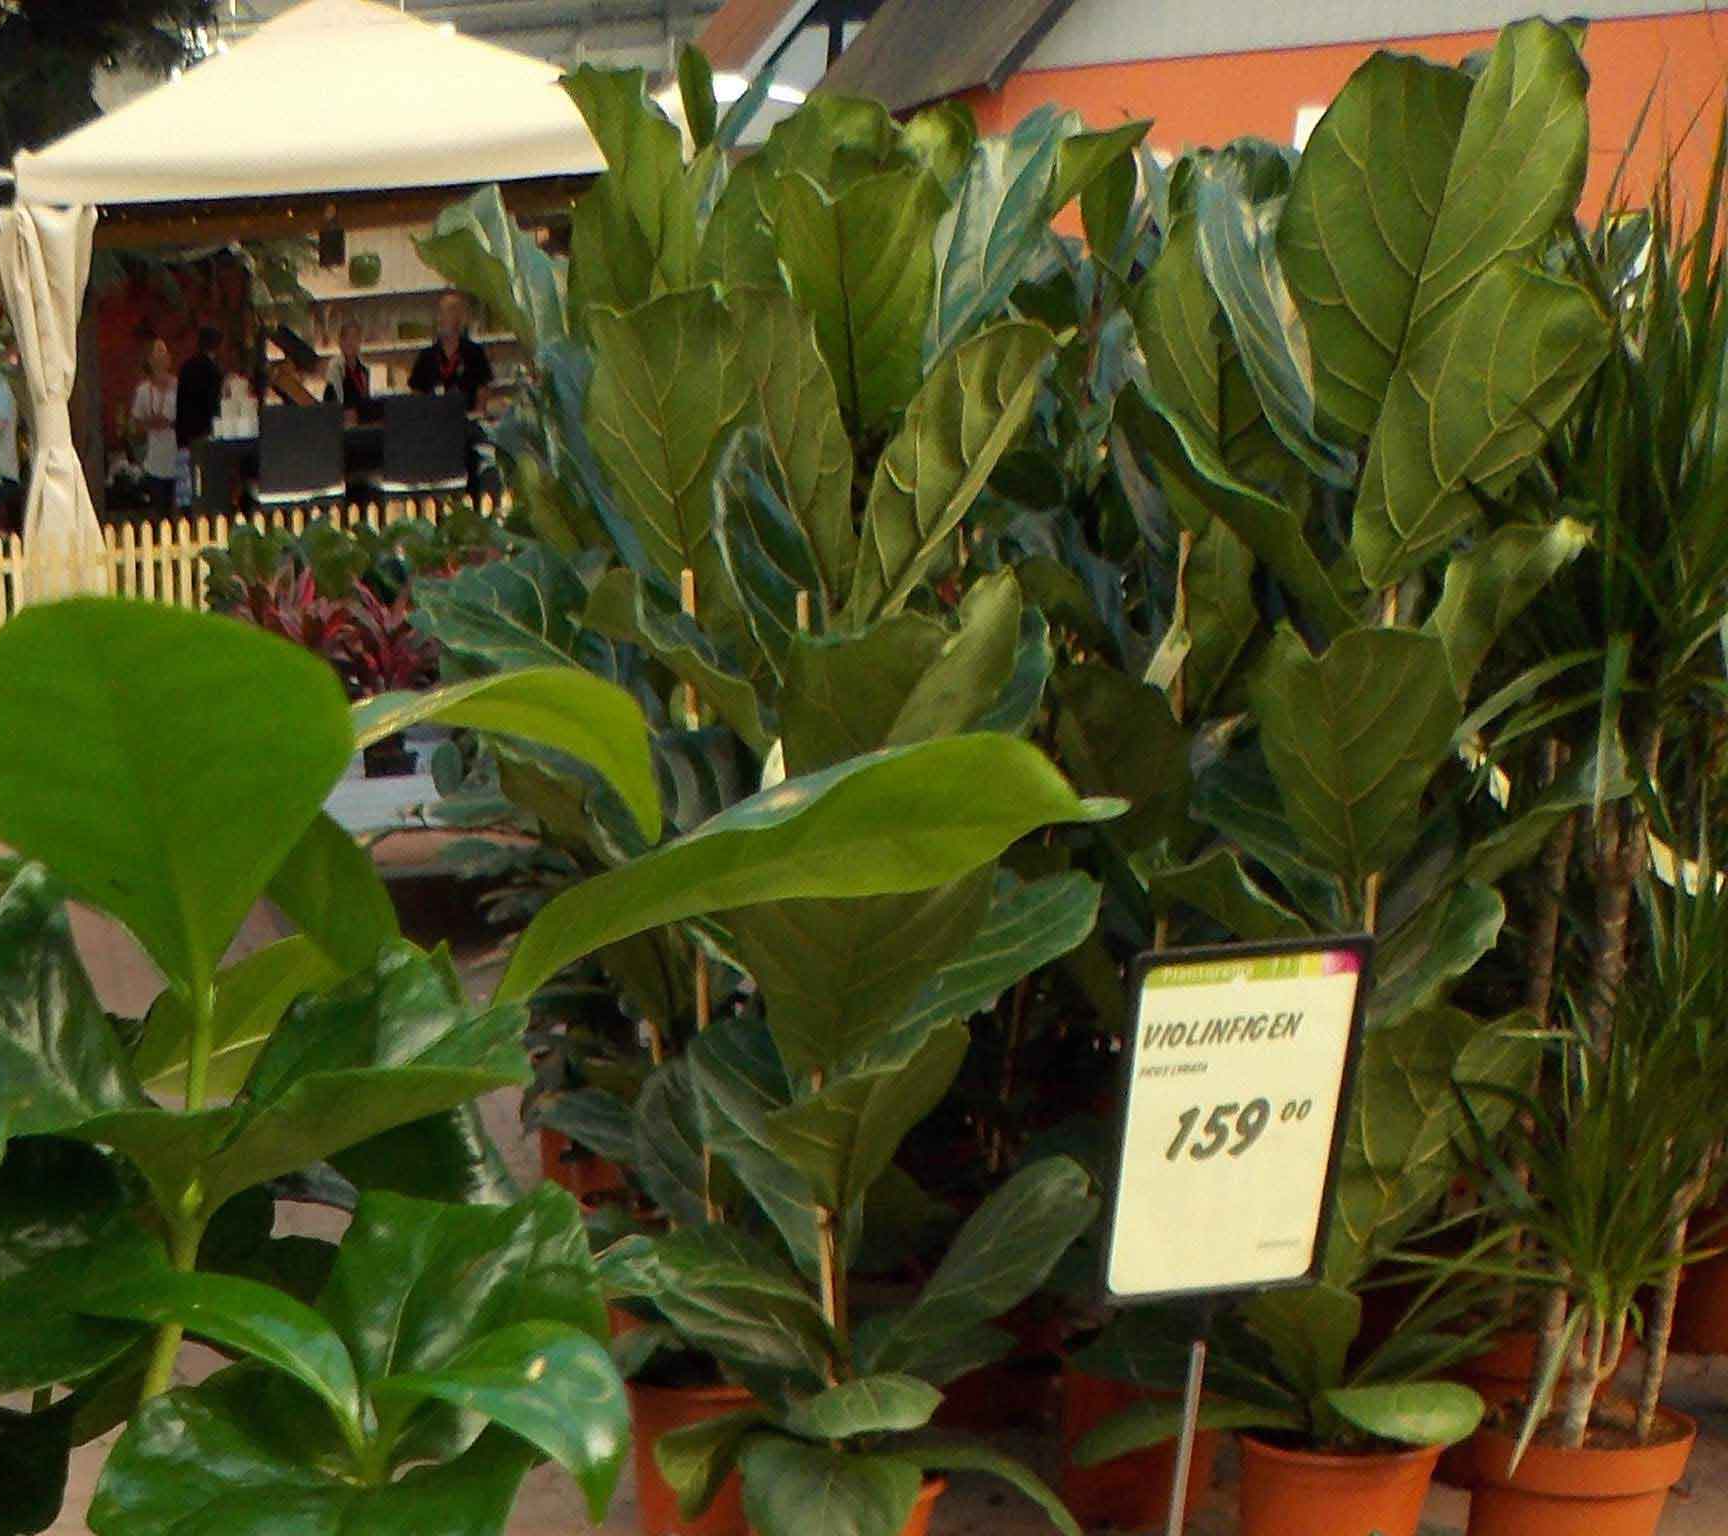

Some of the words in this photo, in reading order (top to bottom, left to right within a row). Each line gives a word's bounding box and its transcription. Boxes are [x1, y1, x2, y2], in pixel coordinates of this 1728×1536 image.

[1143, 1012, 1304, 1050] VIOLINFIGEN
[1165, 1097, 1271, 1162] 159
[1279, 1098, 1313, 1124] 00
